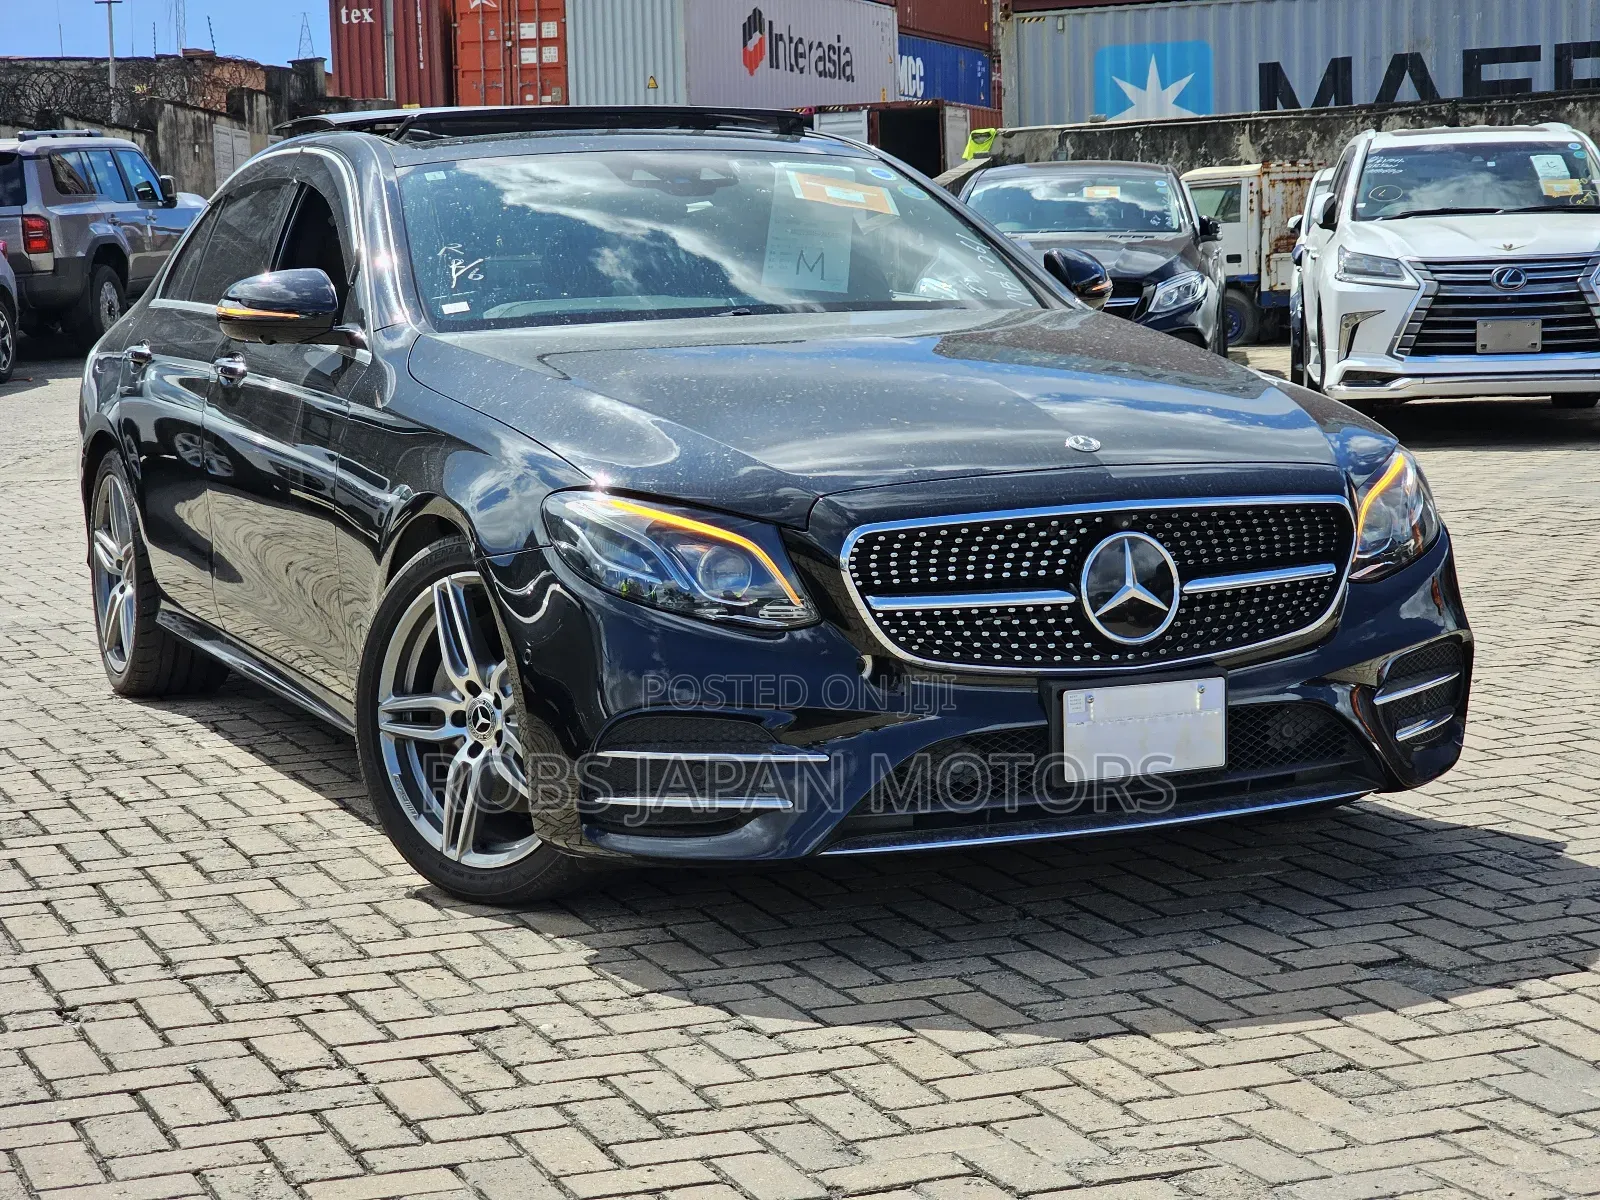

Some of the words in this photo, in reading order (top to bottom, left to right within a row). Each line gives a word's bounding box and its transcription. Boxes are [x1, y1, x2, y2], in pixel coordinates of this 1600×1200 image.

[341, 5, 375, 24] tex
[768, 20, 855, 83] Interasia
[795, 249, 826, 281] M
